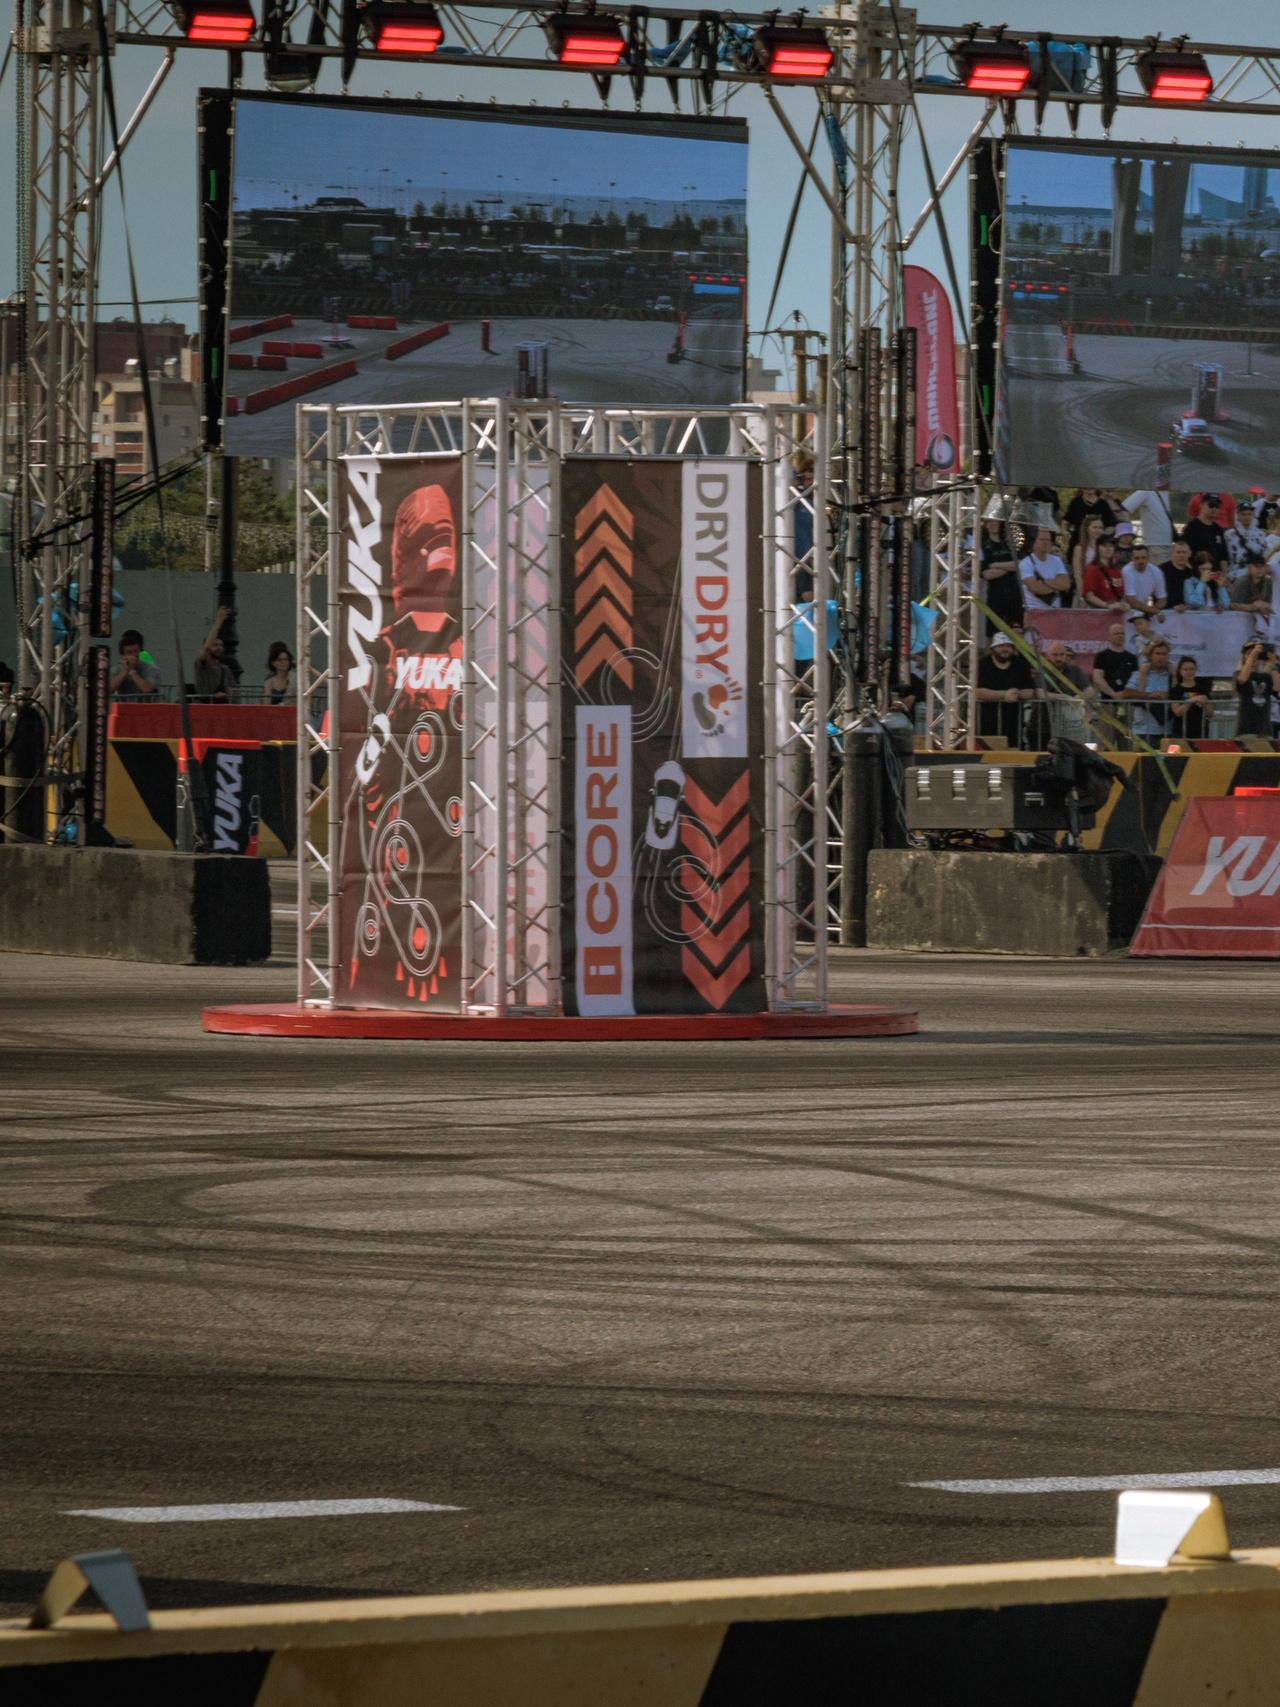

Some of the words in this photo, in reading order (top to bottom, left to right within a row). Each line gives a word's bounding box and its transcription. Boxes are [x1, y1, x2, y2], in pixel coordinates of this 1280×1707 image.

[347, 458, 382, 691] YUKA
[396, 657, 464, 690] YUKA
[213, 753, 243, 851] YUKA
